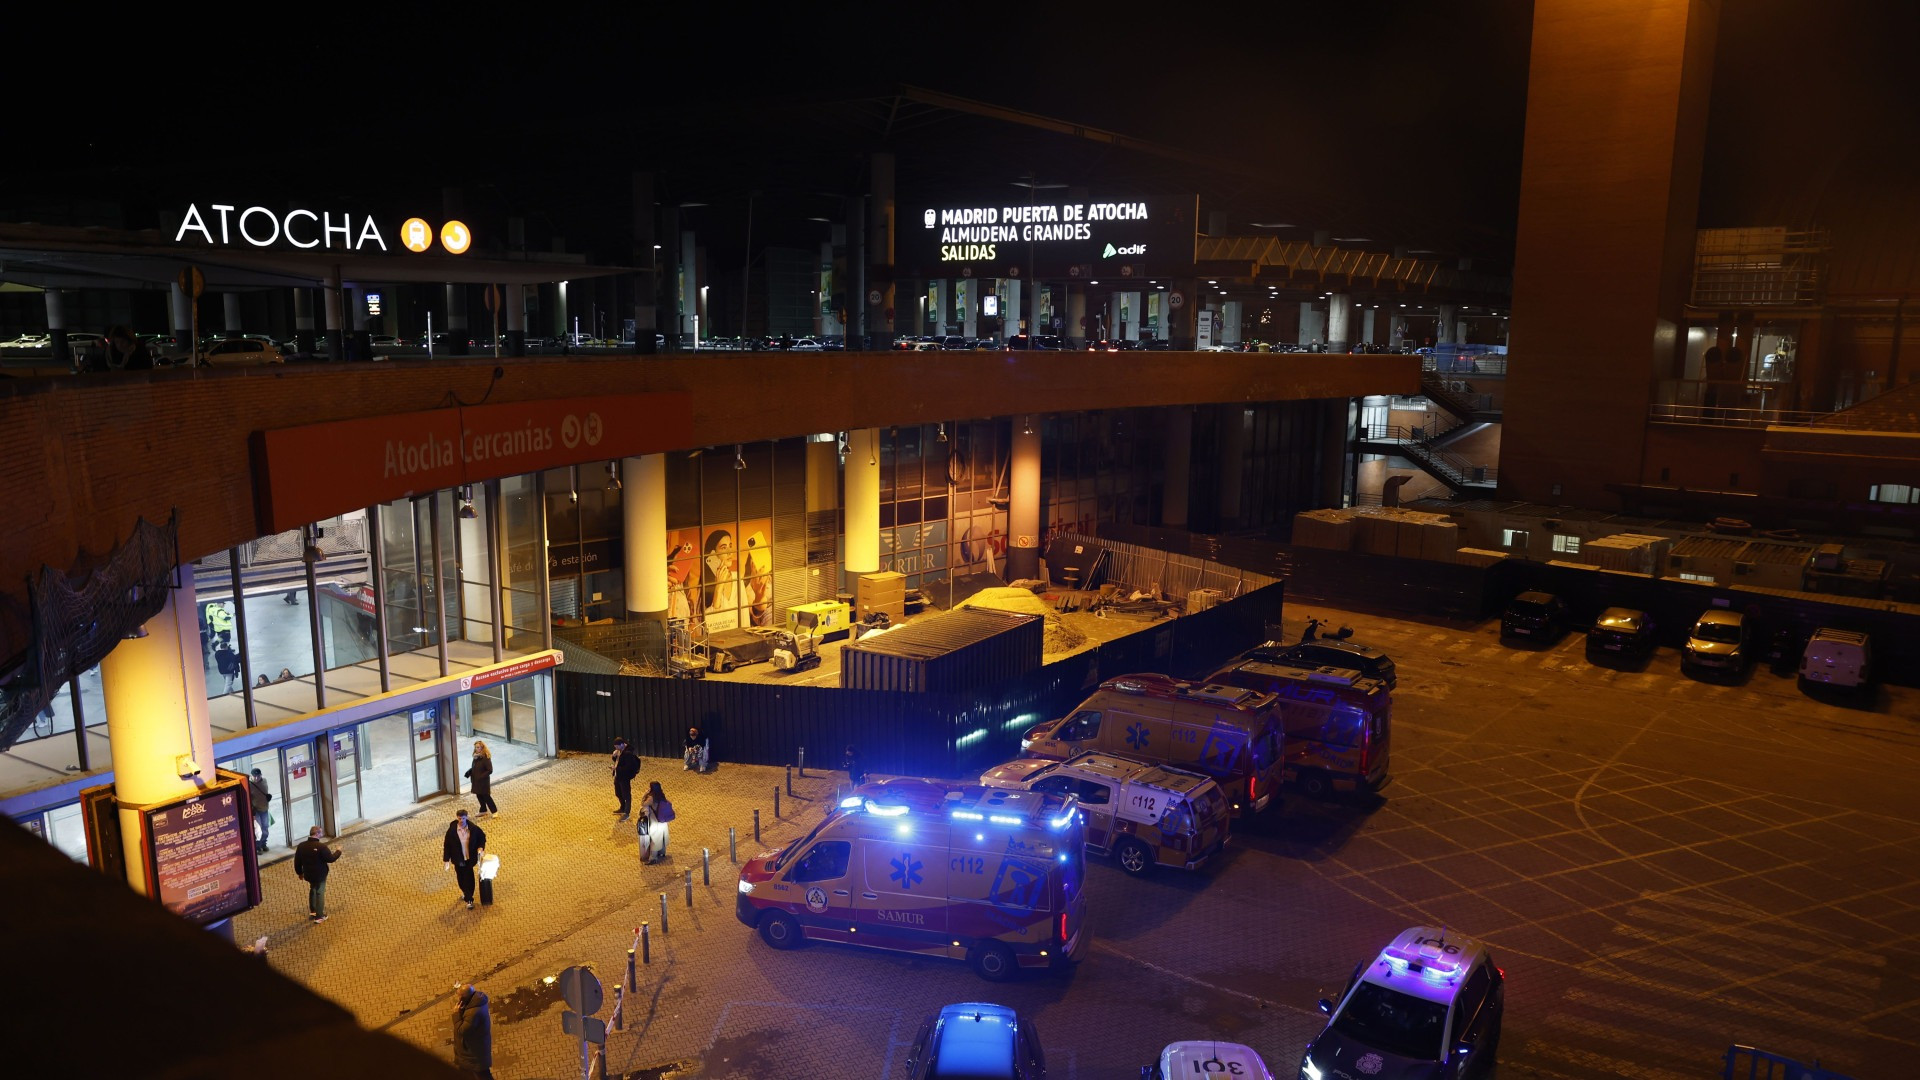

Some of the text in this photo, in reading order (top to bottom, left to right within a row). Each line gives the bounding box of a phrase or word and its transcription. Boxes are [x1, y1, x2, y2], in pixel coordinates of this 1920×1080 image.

[942, 202, 1148, 225] MADRID PUERTA DE ATOCHA
[175, 203, 387, 251] ATOCHA
[942, 223, 1091, 243] ALMUDENA GRANDES
[941, 244, 996, 261] SALIDAS
[1117, 243, 1147, 256] adif
[1170, 296, 1182, 304] 20
[384, 418, 553, 479] Atocha Cercanías
[877, 909, 925, 925] SAMUR
